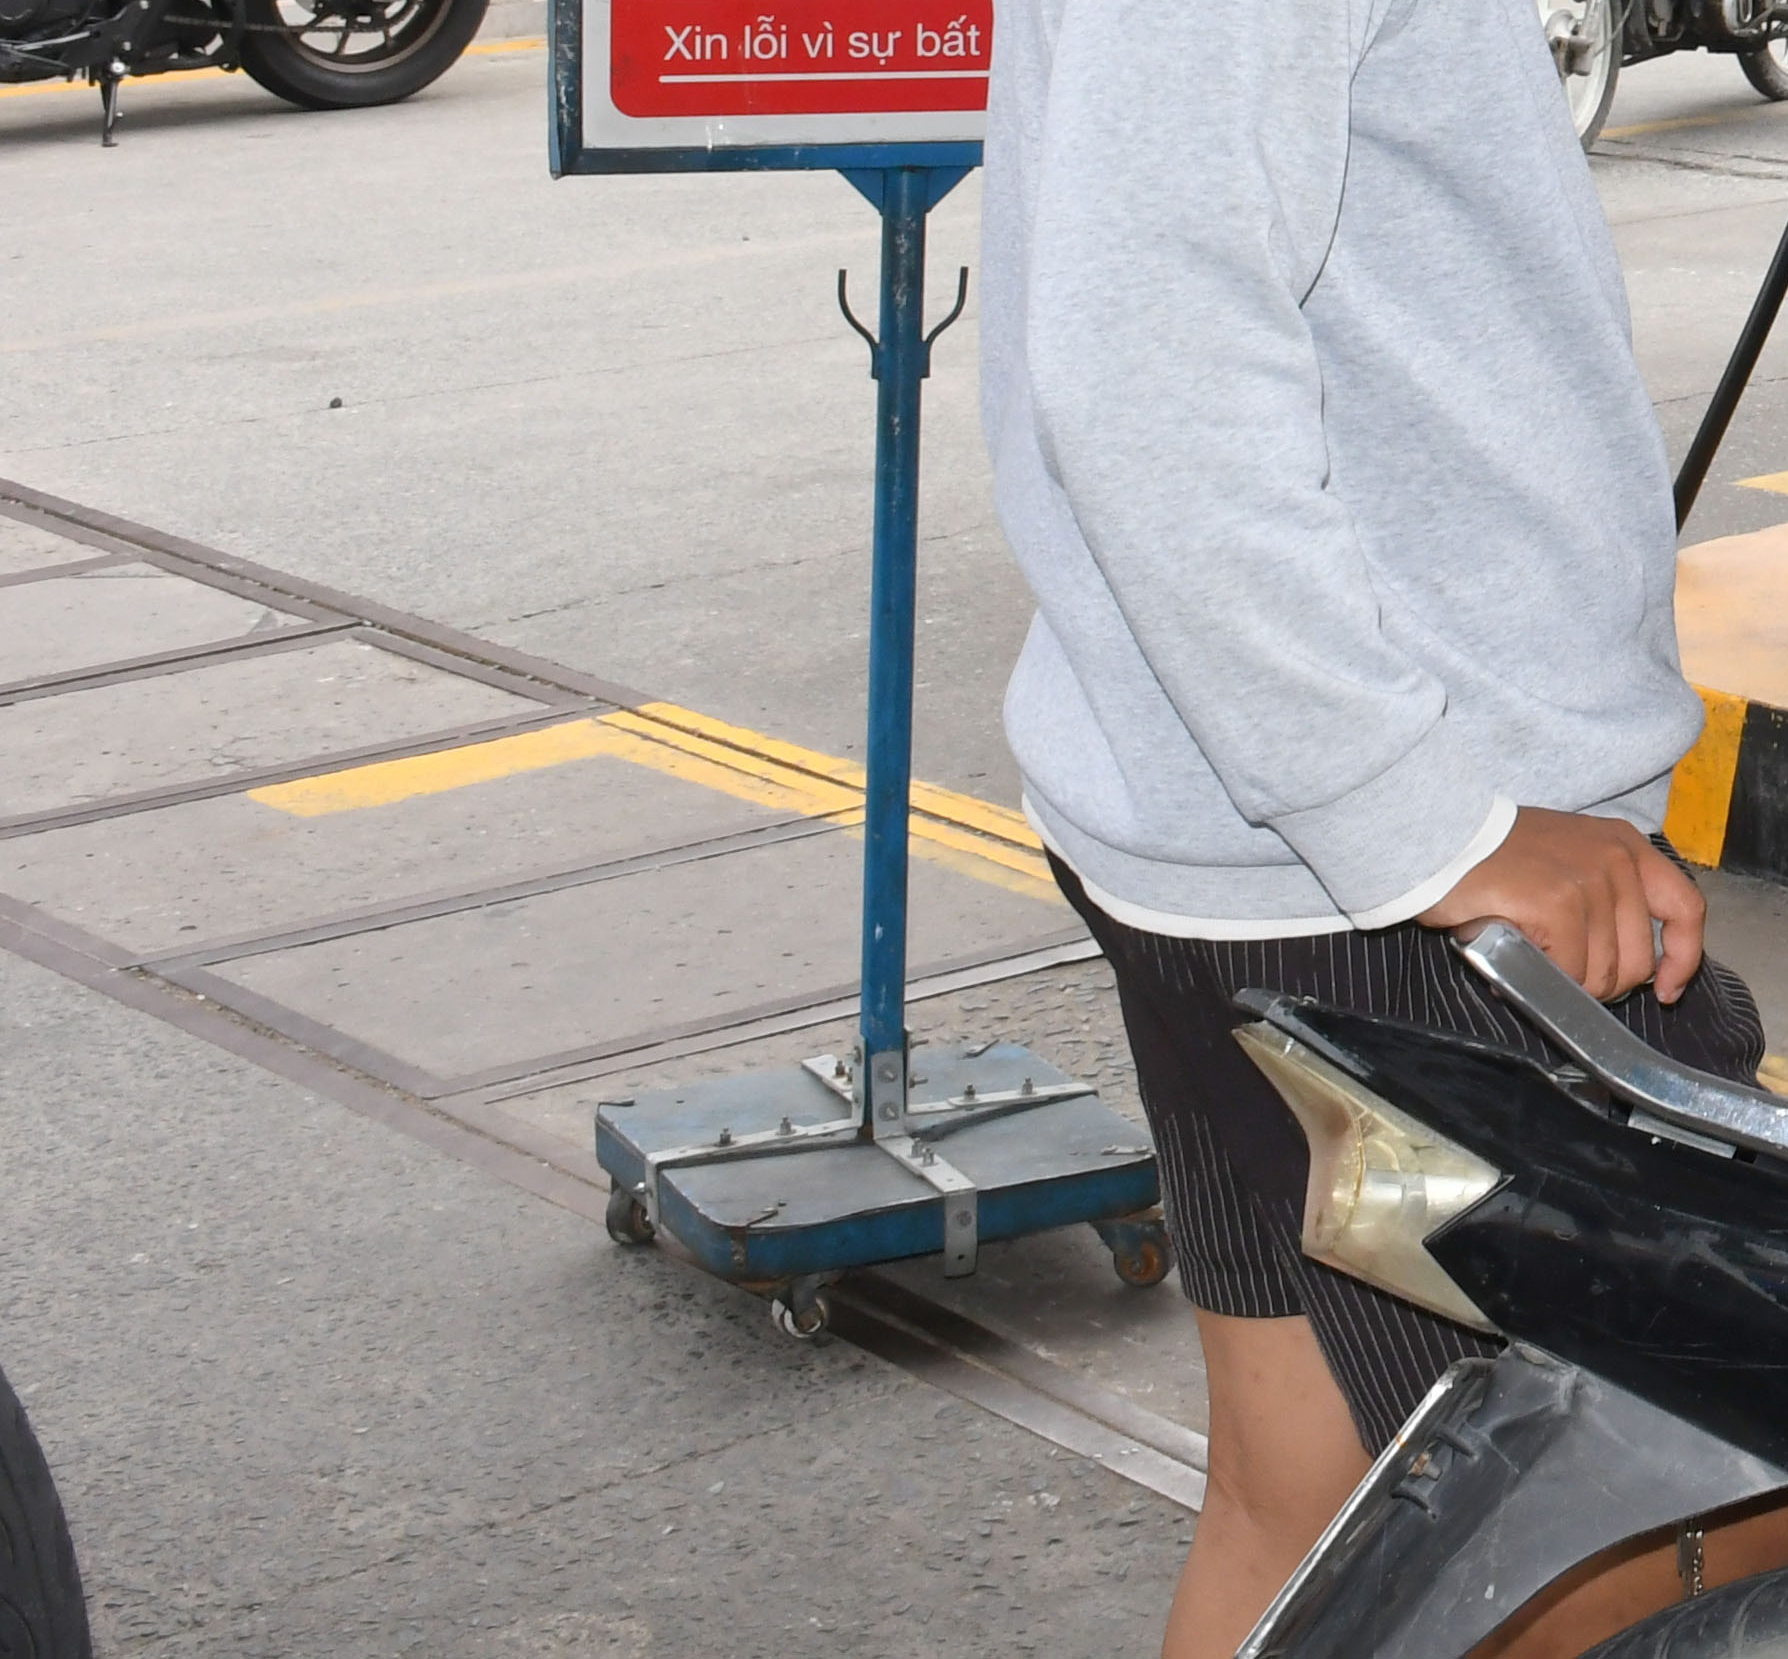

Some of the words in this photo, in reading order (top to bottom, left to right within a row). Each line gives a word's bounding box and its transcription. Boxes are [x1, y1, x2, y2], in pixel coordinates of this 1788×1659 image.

[663, 24, 728, 61] Xin
[744, 15, 788, 60] lỗi
[802, 22, 834, 59] vì
[847, 31, 902, 65] sự
[915, 15, 981, 58] bất
